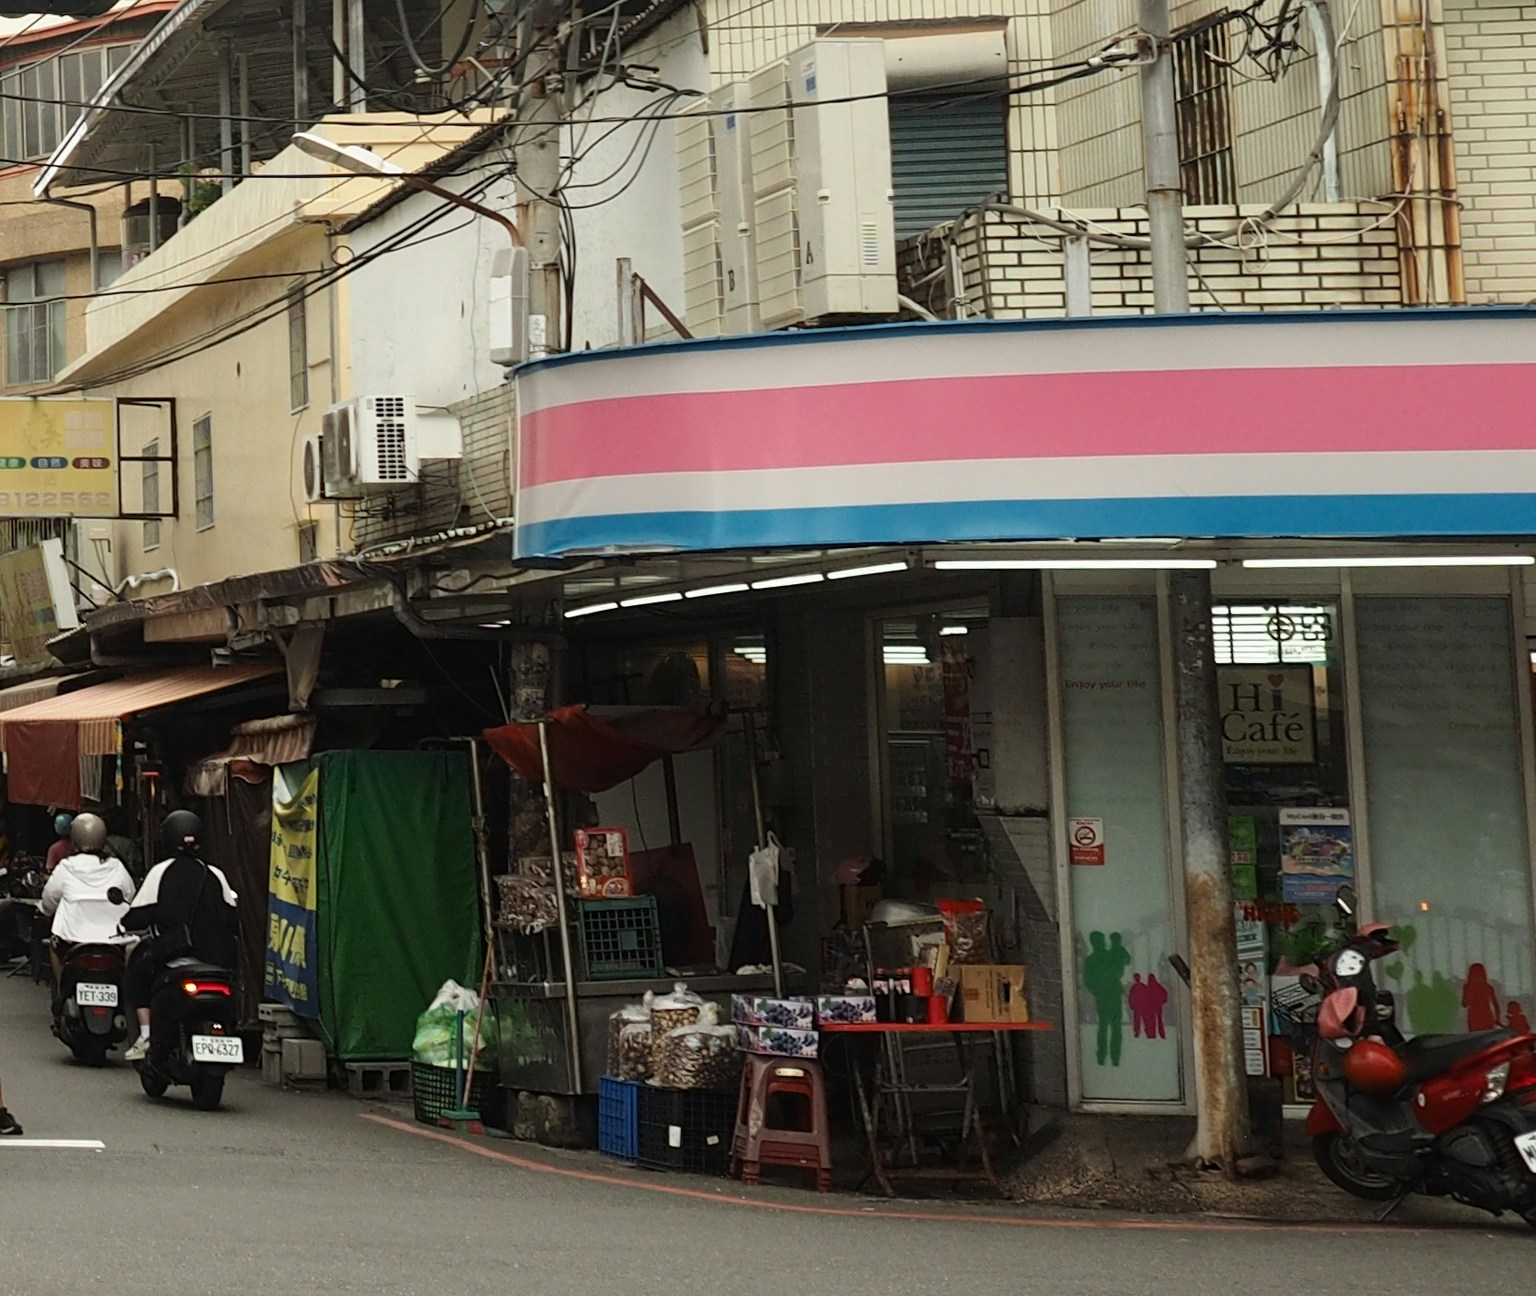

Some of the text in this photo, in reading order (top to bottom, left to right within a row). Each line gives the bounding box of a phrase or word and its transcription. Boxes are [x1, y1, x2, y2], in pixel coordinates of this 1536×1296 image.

[37, 457, 62, 468] 自然
[1064, 678, 1096, 690] Enjoy
[1098, 680, 1124, 691] your
[1229, 674, 1284, 712] Hi
[1221, 712, 1305, 743] Café
[78, 989, 117, 1003] YET-339
[194, 1042, 240, 1057] EPQ-6327
